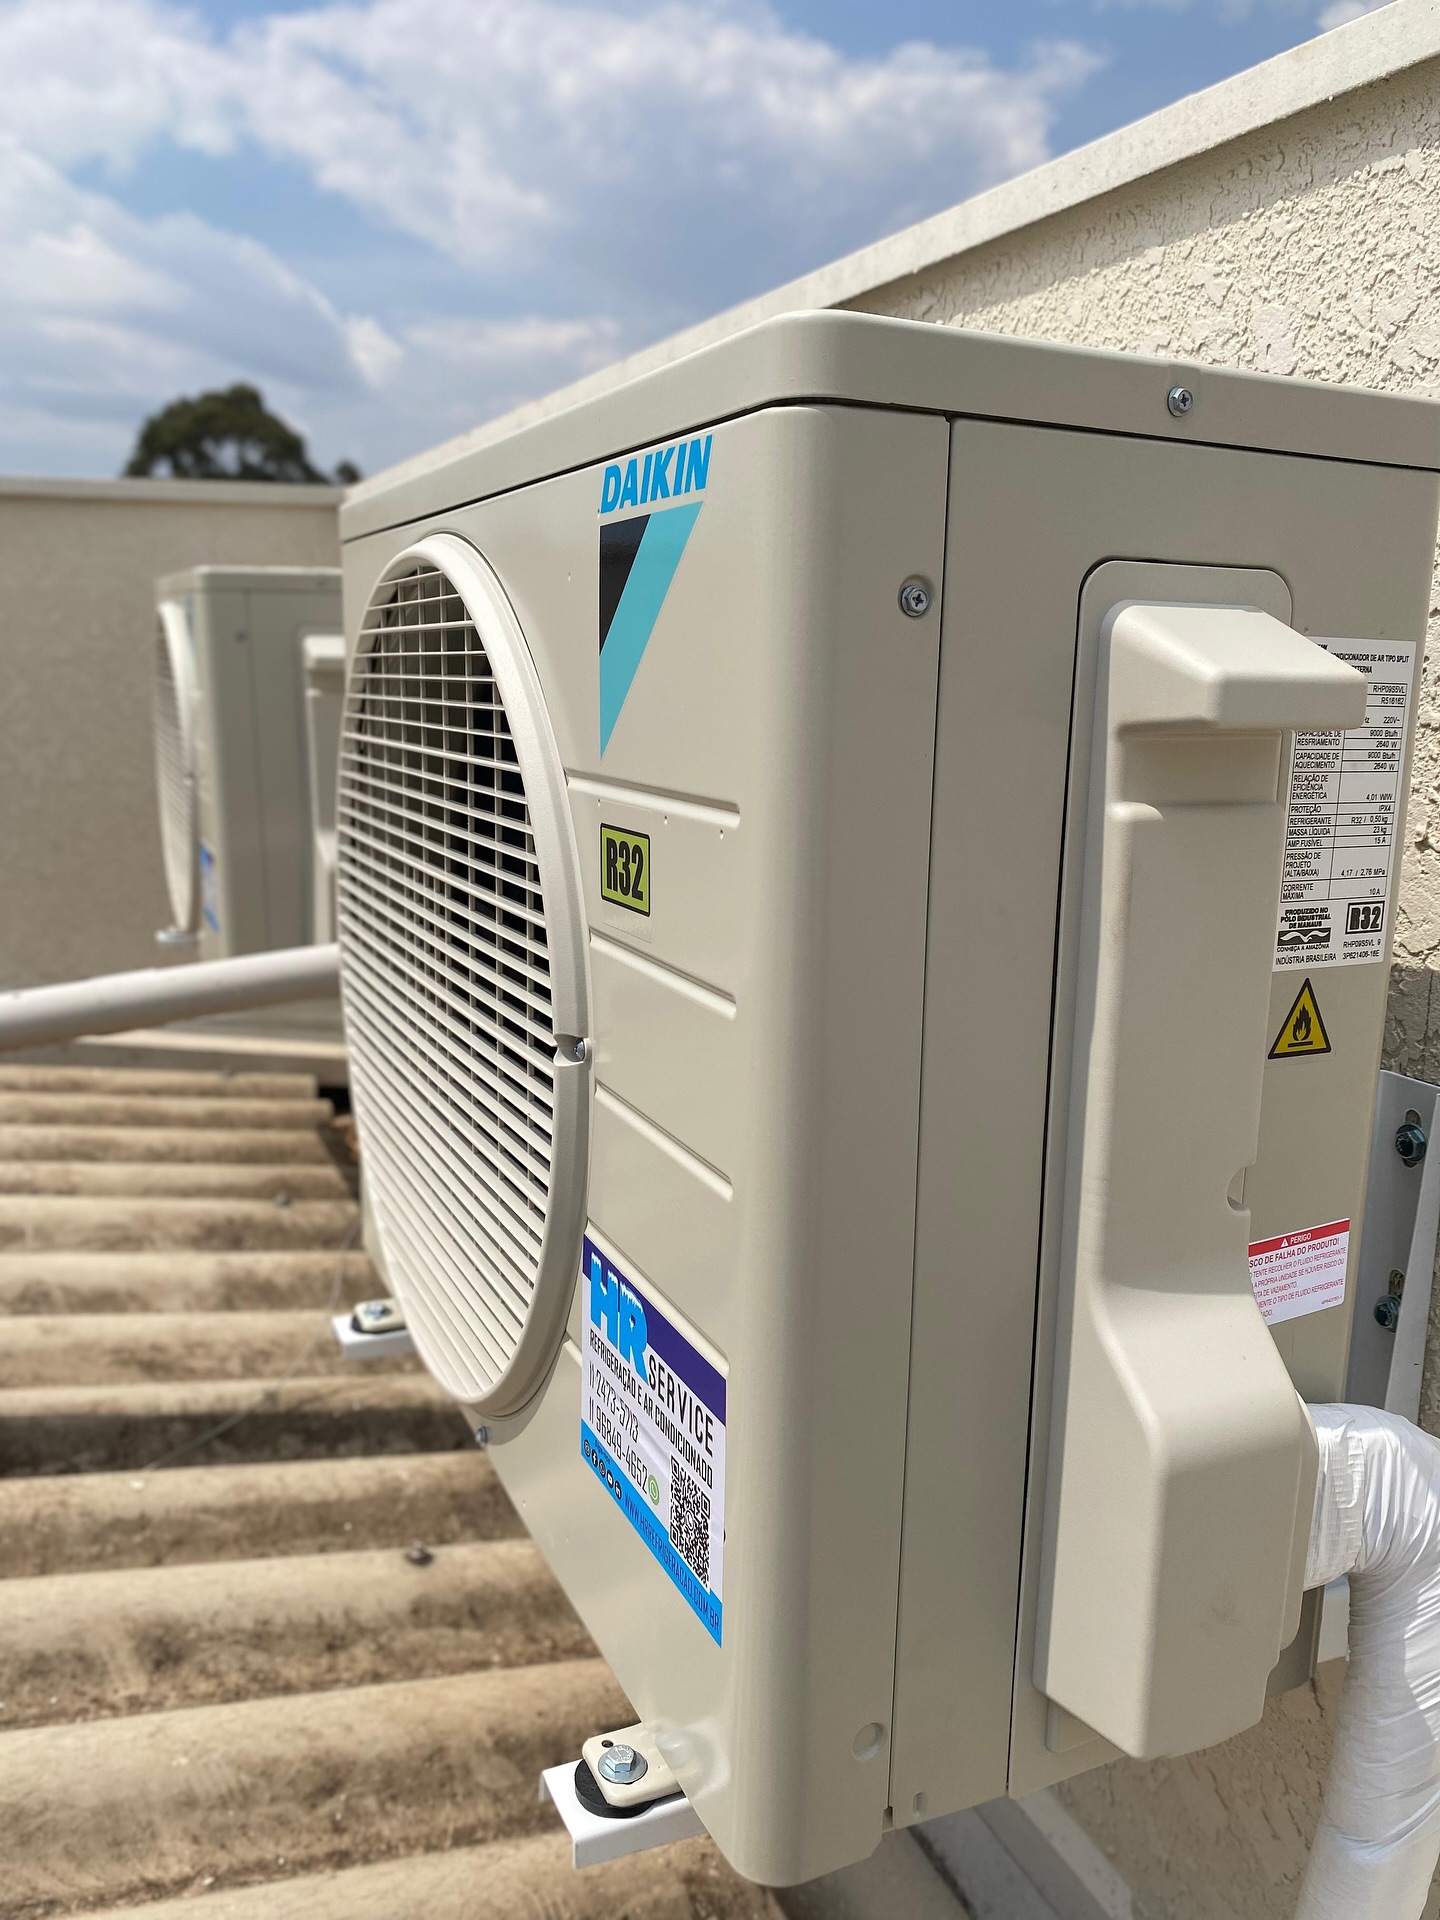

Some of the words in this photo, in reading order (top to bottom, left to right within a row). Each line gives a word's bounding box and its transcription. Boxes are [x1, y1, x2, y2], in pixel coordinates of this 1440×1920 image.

[601, 435, 713, 513] DAIKIN
[1377, 654, 1384, 662] AR
[1397, 655, 1409, 663] SPLIT
[1373, 685, 1405, 694] RHP09S5VL
[1297, 738, 1340, 746] RESFRIAMENTO
[1295, 761, 1335, 769] AQUECIMENTO
[1294, 774, 1320, 784] RELAÇÃO
[1293, 783, 1323, 791] EFICIÊNCIA
[1292, 791, 1327, 799] ENERGÉTICA
[1291, 804, 1321, 814] PROTEÇÃO
[1290, 817, 1331, 825] REFRIGERANTE
[1289, 828, 1308, 836] MASSA
[1309, 827, 1330, 835] LÍQUIDA
[1381, 827, 1387, 835] kg
[1301, 838, 1323, 847] FUSÍVEL
[1287, 851, 1312, 860] PRESSÃO
[606, 837, 645, 901] R32
[1286, 861, 1311, 869] PROJETO
[1285, 869, 1319, 878] (ALTA/BAIXA)
[1283, 883, 1313, 892] CORRENTE
[1285, 908, 1319, 916] PRODUZIDO
[1297, 914, 1331, 922] INDUSTRIAL
[1350, 906, 1381, 930] R32
[1276, 955, 1305, 965] INDÚSTRIA
[1306, 953, 1336, 963] BRASILEIRA
[1290, 1233, 1311, 1245] PERIGO
[1249, 1259, 1263, 1268] SCO
[1265, 1255, 1274, 1265] DE
[1275, 1250, 1295, 1263] FALHA
[1297, 1247, 1307, 1256] DO
[1307, 1237, 1339, 1252] PRODUTO!
[1253, 1269, 1268, 1278] TENTE
[1268, 1262, 1292, 1273] RECOLHER
[1298, 1256, 1313, 1266] FLUIDO
[1314, 1247, 1346, 1263] REFRIGERANTE
[1279, 1271, 1297, 1282] UNIDADE
[1305, 1264, 1324, 1273] HOUVER
[1324, 1260, 1337, 1270] RISCO
[1263, 1288, 1269, 1296] DE
[1277, 1293, 1288, 1303] TIPO
[1288, 1292, 1295, 1300] DE
[1295, 1288, 1310, 1299] FLUIDO
[1311, 1278, 1344, 1292] REFRIGERANTE
[590, 1252, 649, 1386] HR
[648, 1354, 714, 1458] SERVICE
[589, 1328, 636, 1399] REFRIGERAÇÃO
[638, 1385, 642, 1406] E
[644, 1393, 653, 1419] AR
[655, 1405, 713, 1489] CONDICIONADO
[596, 1406, 648, 1494] 96849-4652
